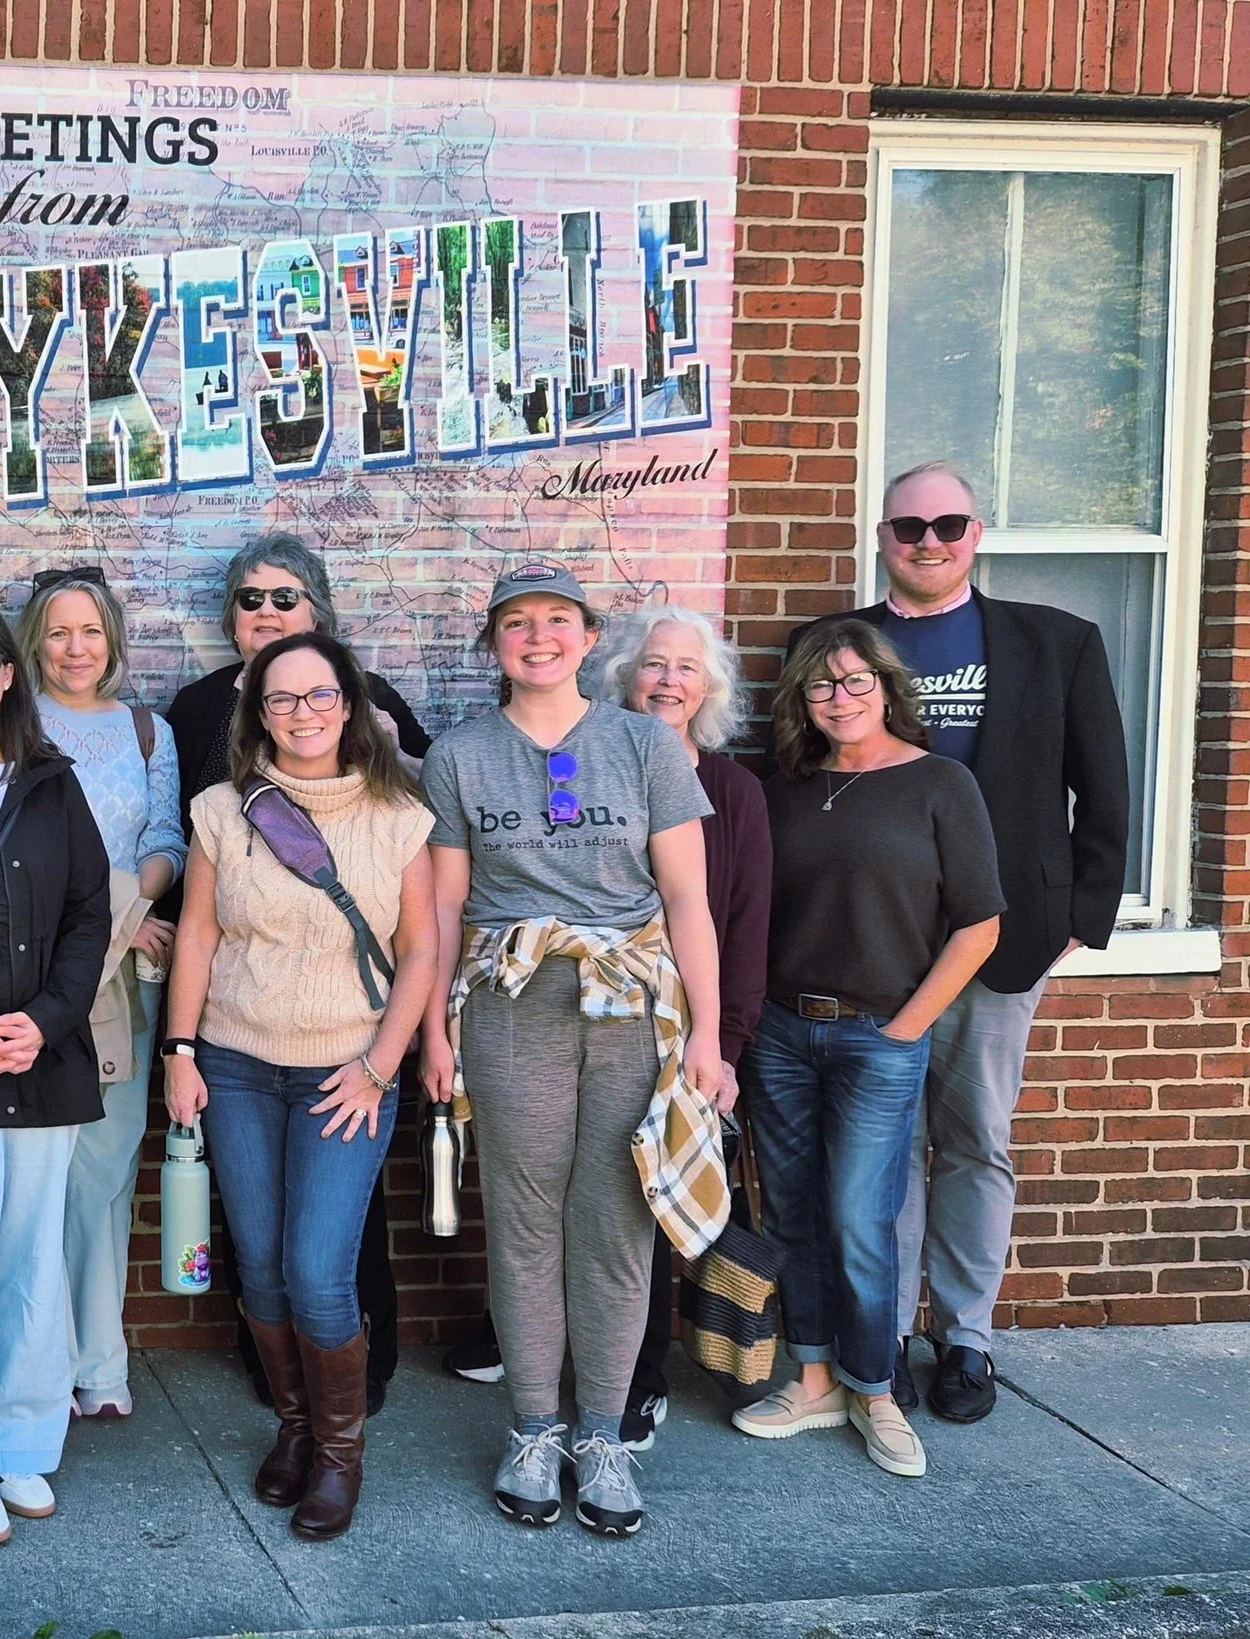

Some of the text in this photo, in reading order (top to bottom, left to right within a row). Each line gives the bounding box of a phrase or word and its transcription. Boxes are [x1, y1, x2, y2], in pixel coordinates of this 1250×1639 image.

[125, 79, 291, 115] FREEDOM
[251, 145, 310, 157] LOUISVILLE
[540, 448, 718, 500] Maryland
[198, 495, 242, 506] FREEDOM
[477, 806, 522, 834] be
[506, 839, 544, 850] world
[548, 838, 578, 849] will
[584, 836, 629, 848] adjust
